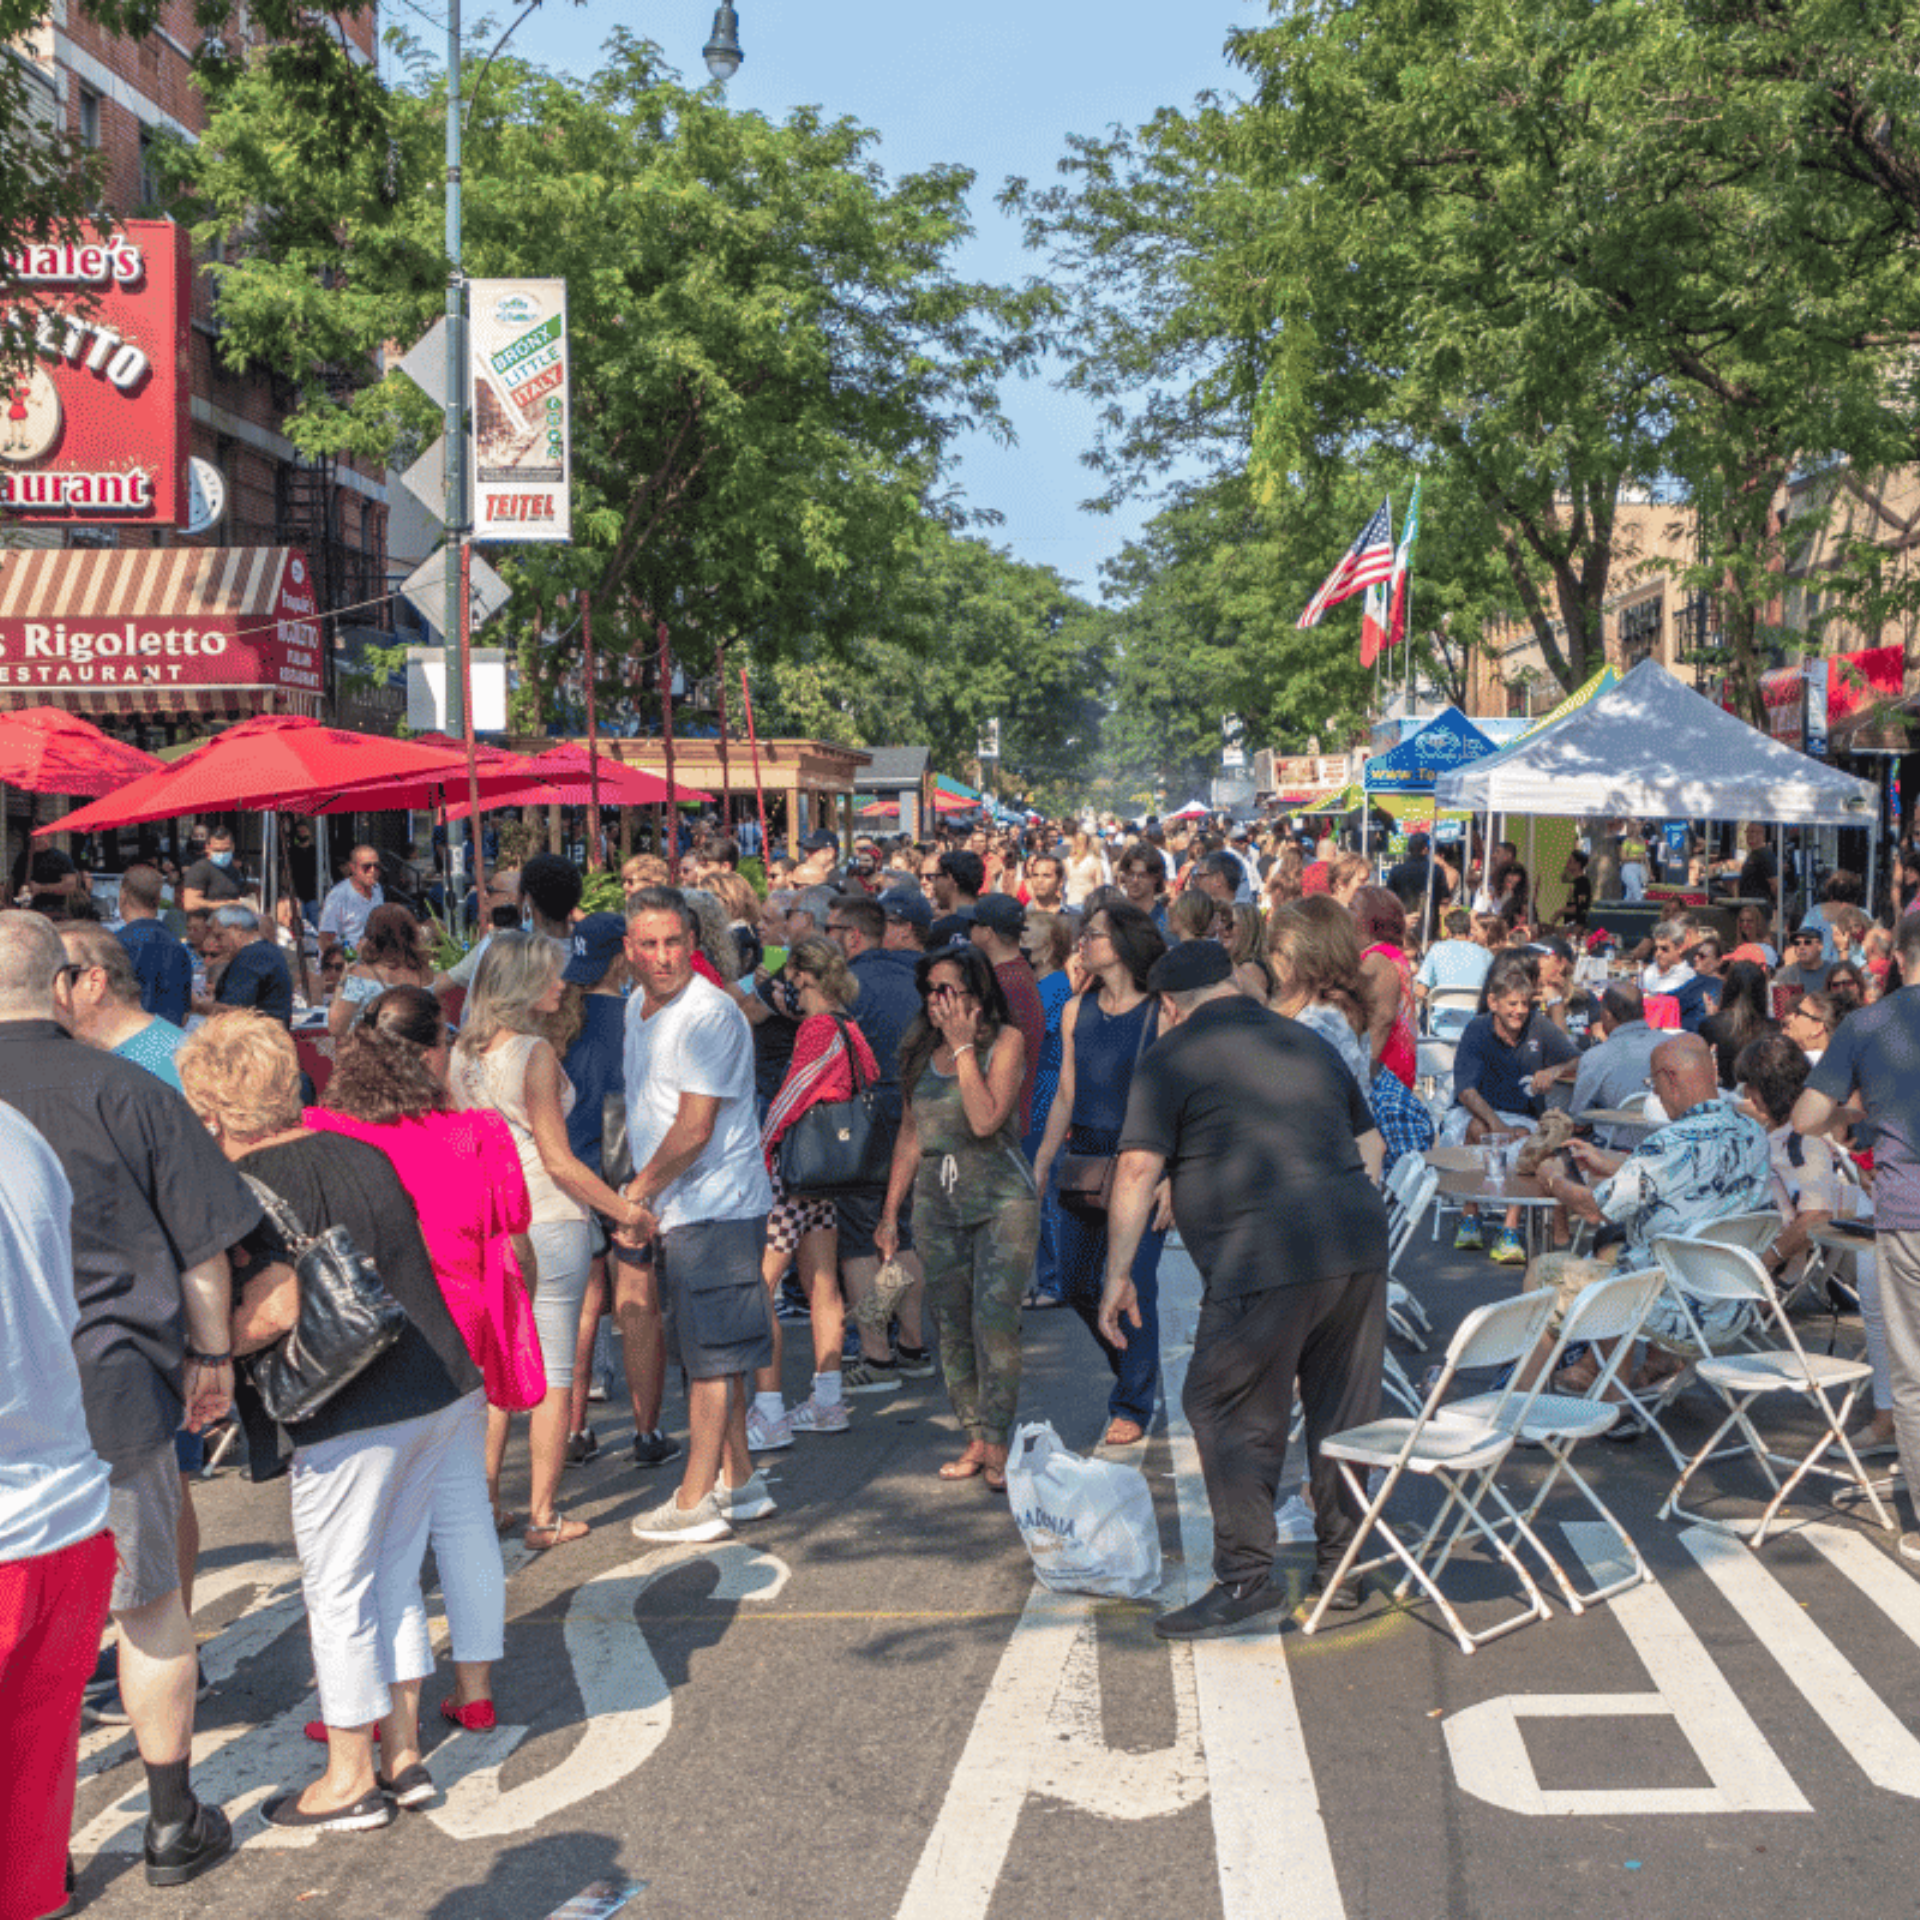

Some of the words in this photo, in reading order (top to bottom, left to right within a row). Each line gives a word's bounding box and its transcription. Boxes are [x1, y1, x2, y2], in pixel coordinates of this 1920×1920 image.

[492, 325, 552, 372] BRONX
[503, 345, 562, 388] LITTLE
[513, 365, 562, 406] ITALY
[486, 494, 555, 521] TEITEL
[23, 623, 228, 663] Rigoletto
